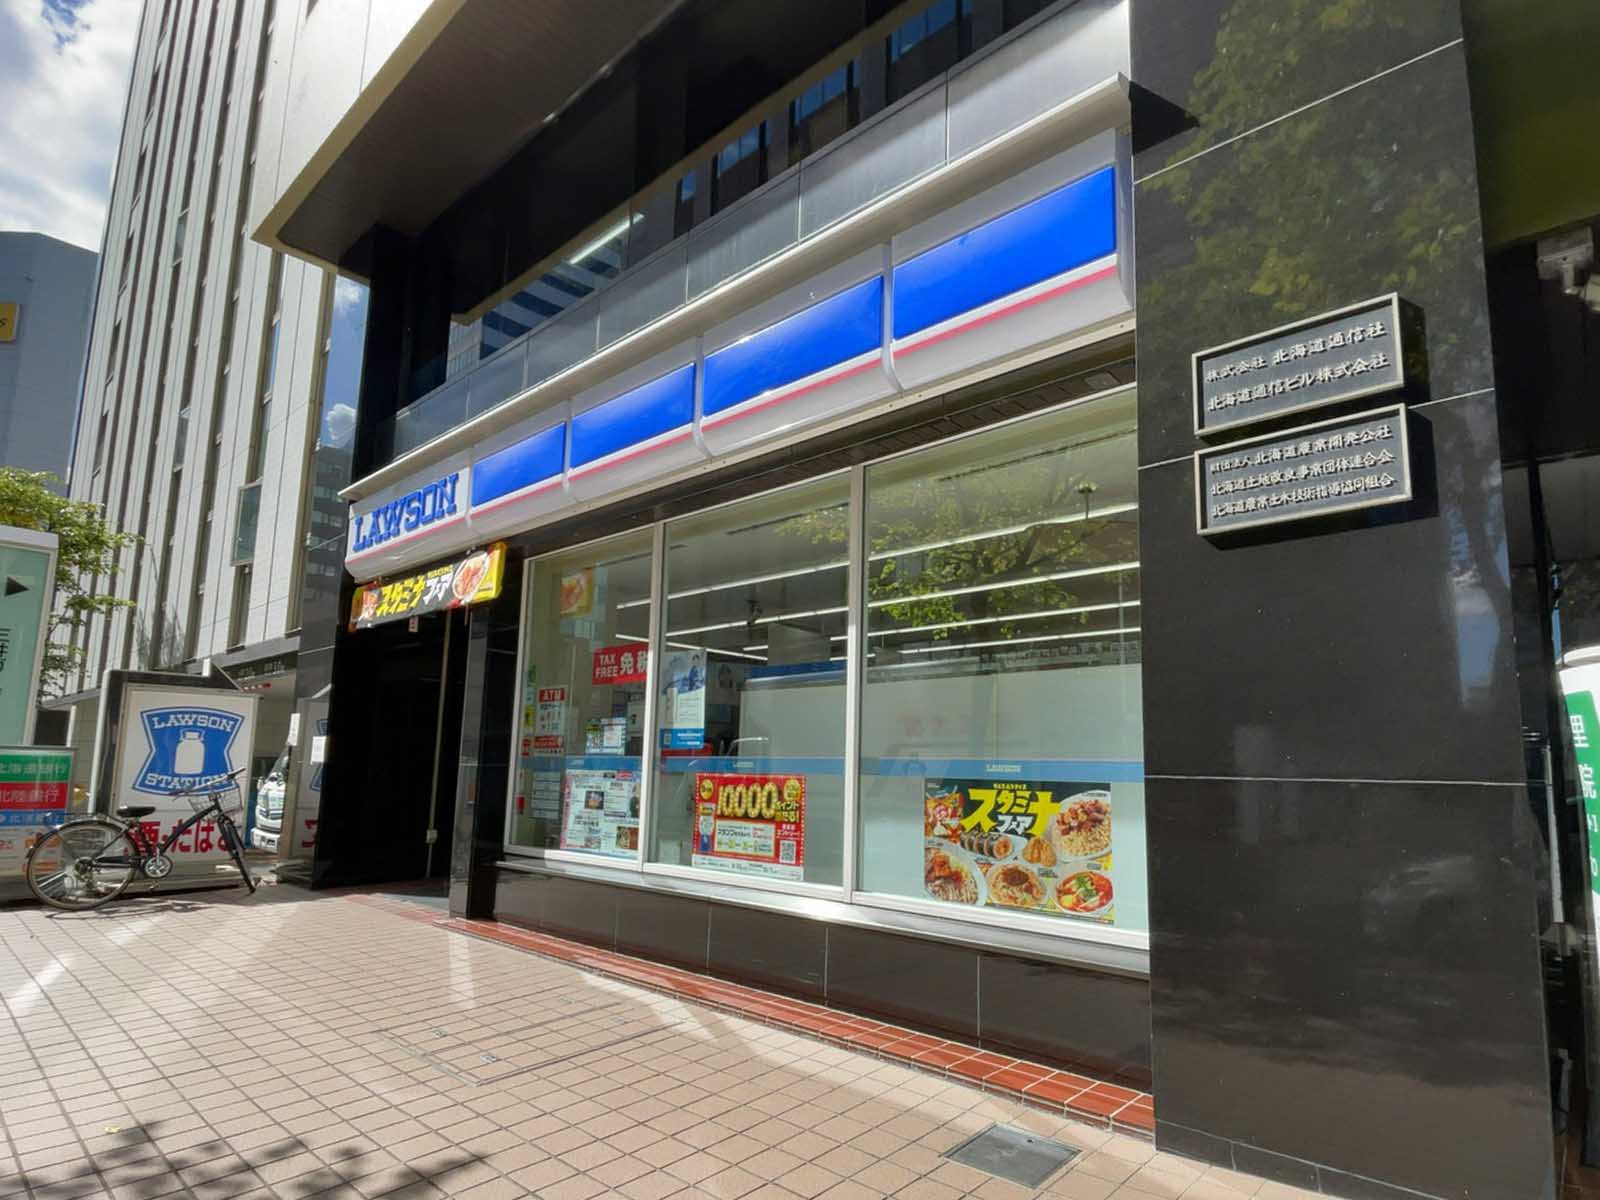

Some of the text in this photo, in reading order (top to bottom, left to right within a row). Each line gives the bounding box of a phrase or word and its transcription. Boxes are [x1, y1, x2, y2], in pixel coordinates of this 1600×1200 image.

[1206, 321, 1388, 382] 株式会社 北海道通信社
[1207, 352, 1392, 412] 北海道通信ビル株式会社
[353, 473, 459, 552] LAWSON
[376, 574, 427, 618] スタミナ
[595, 664, 620, 679] FREE
[599, 653, 616, 667] TAX
[543, 690, 562, 702] ATM
[152, 714, 235, 733] LAWSON
[960, 788, 1061, 838] スタミナ
[997, 815, 1033, 834] フェア
